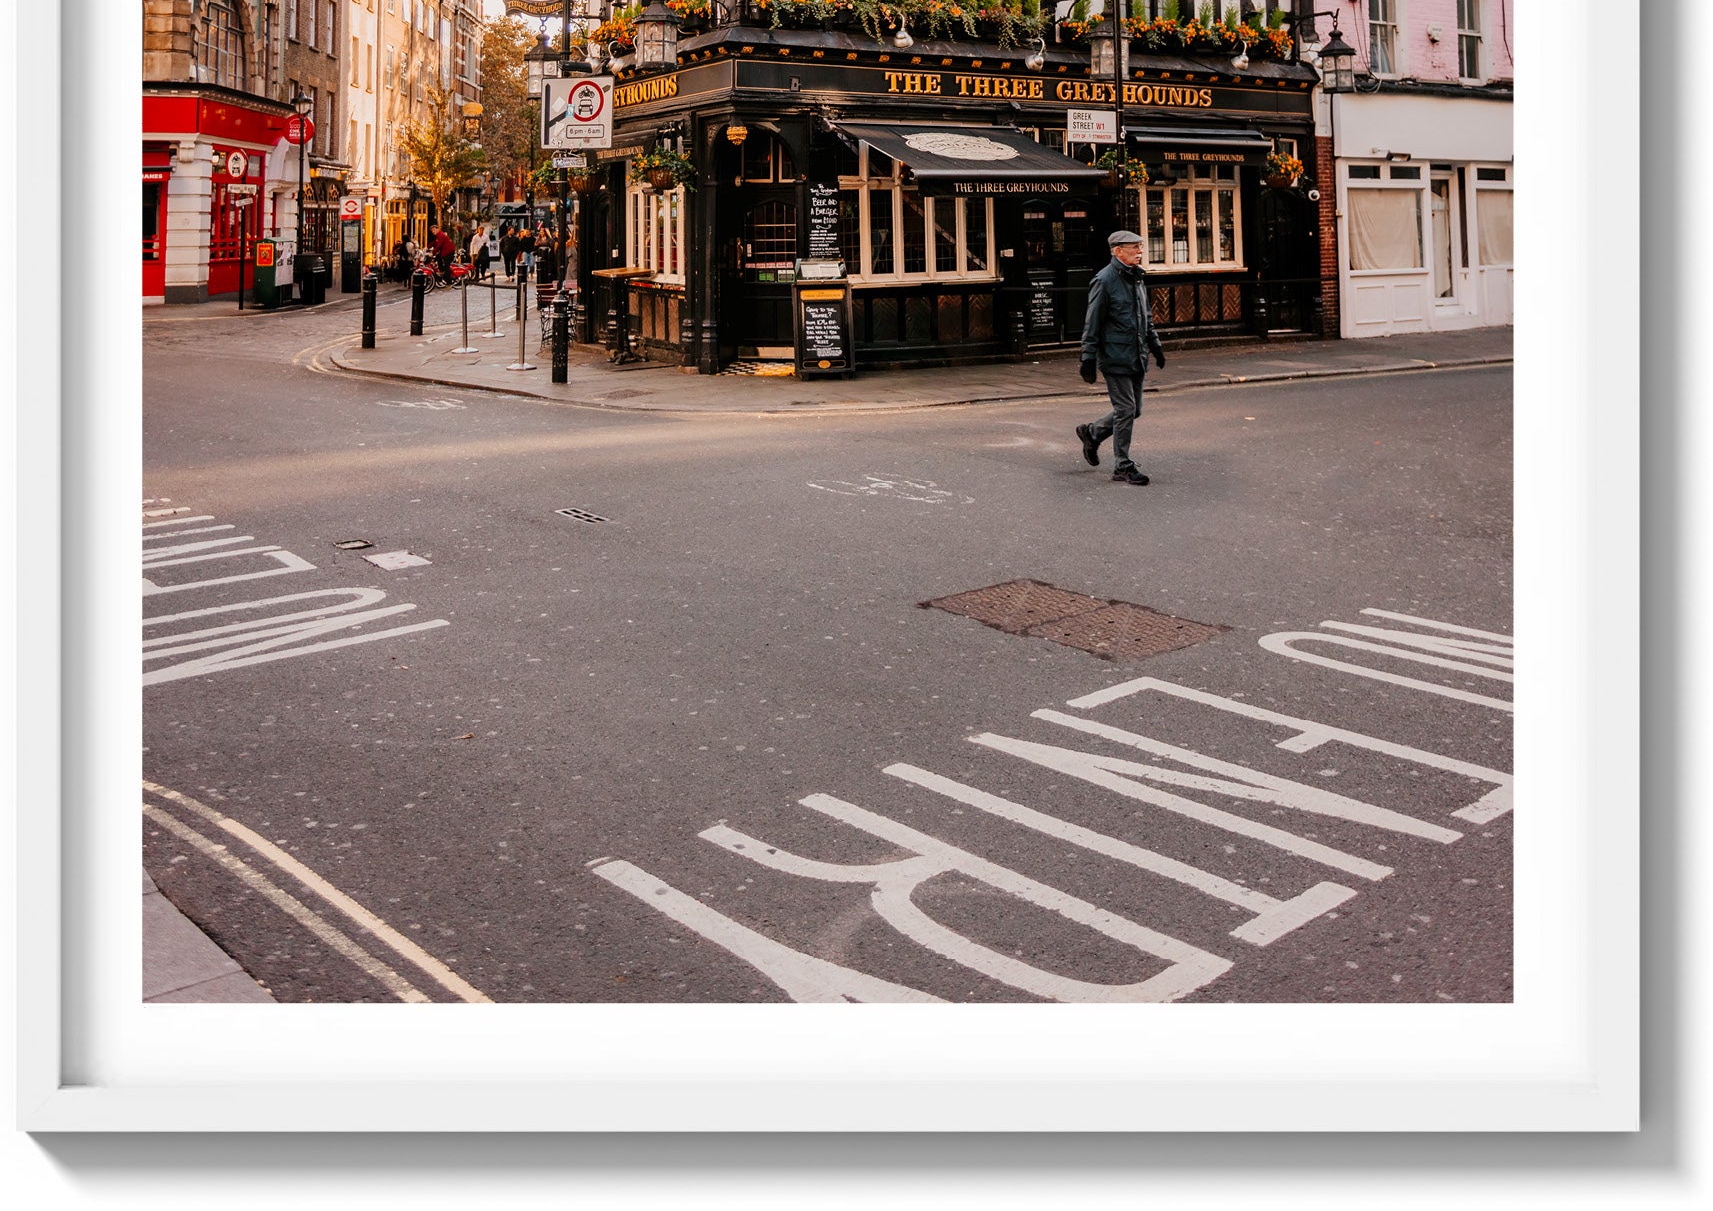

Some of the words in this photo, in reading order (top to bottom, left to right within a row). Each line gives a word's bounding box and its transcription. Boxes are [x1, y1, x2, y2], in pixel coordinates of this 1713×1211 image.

[885, 71, 941, 95] THE
[956, 75, 1044, 100] THREE
[1056, 80, 1213, 107] GREYHOUNDS
[1072, 112, 1092, 120] GREEK
[1072, 121, 1094, 130] STREET
[1096, 122, 1105, 130] W1
[1163, 152, 1177, 160] THE
[1179, 152, 1200, 161] THREE
[1202, 153, 1245, 162] GREYHOUNDS
[954, 182, 974, 193] THE
[974, 182, 1005, 193] THREE
[1006, 182, 1069, 193] GREYHOUNDS
[810, 207, 815, 216] A
